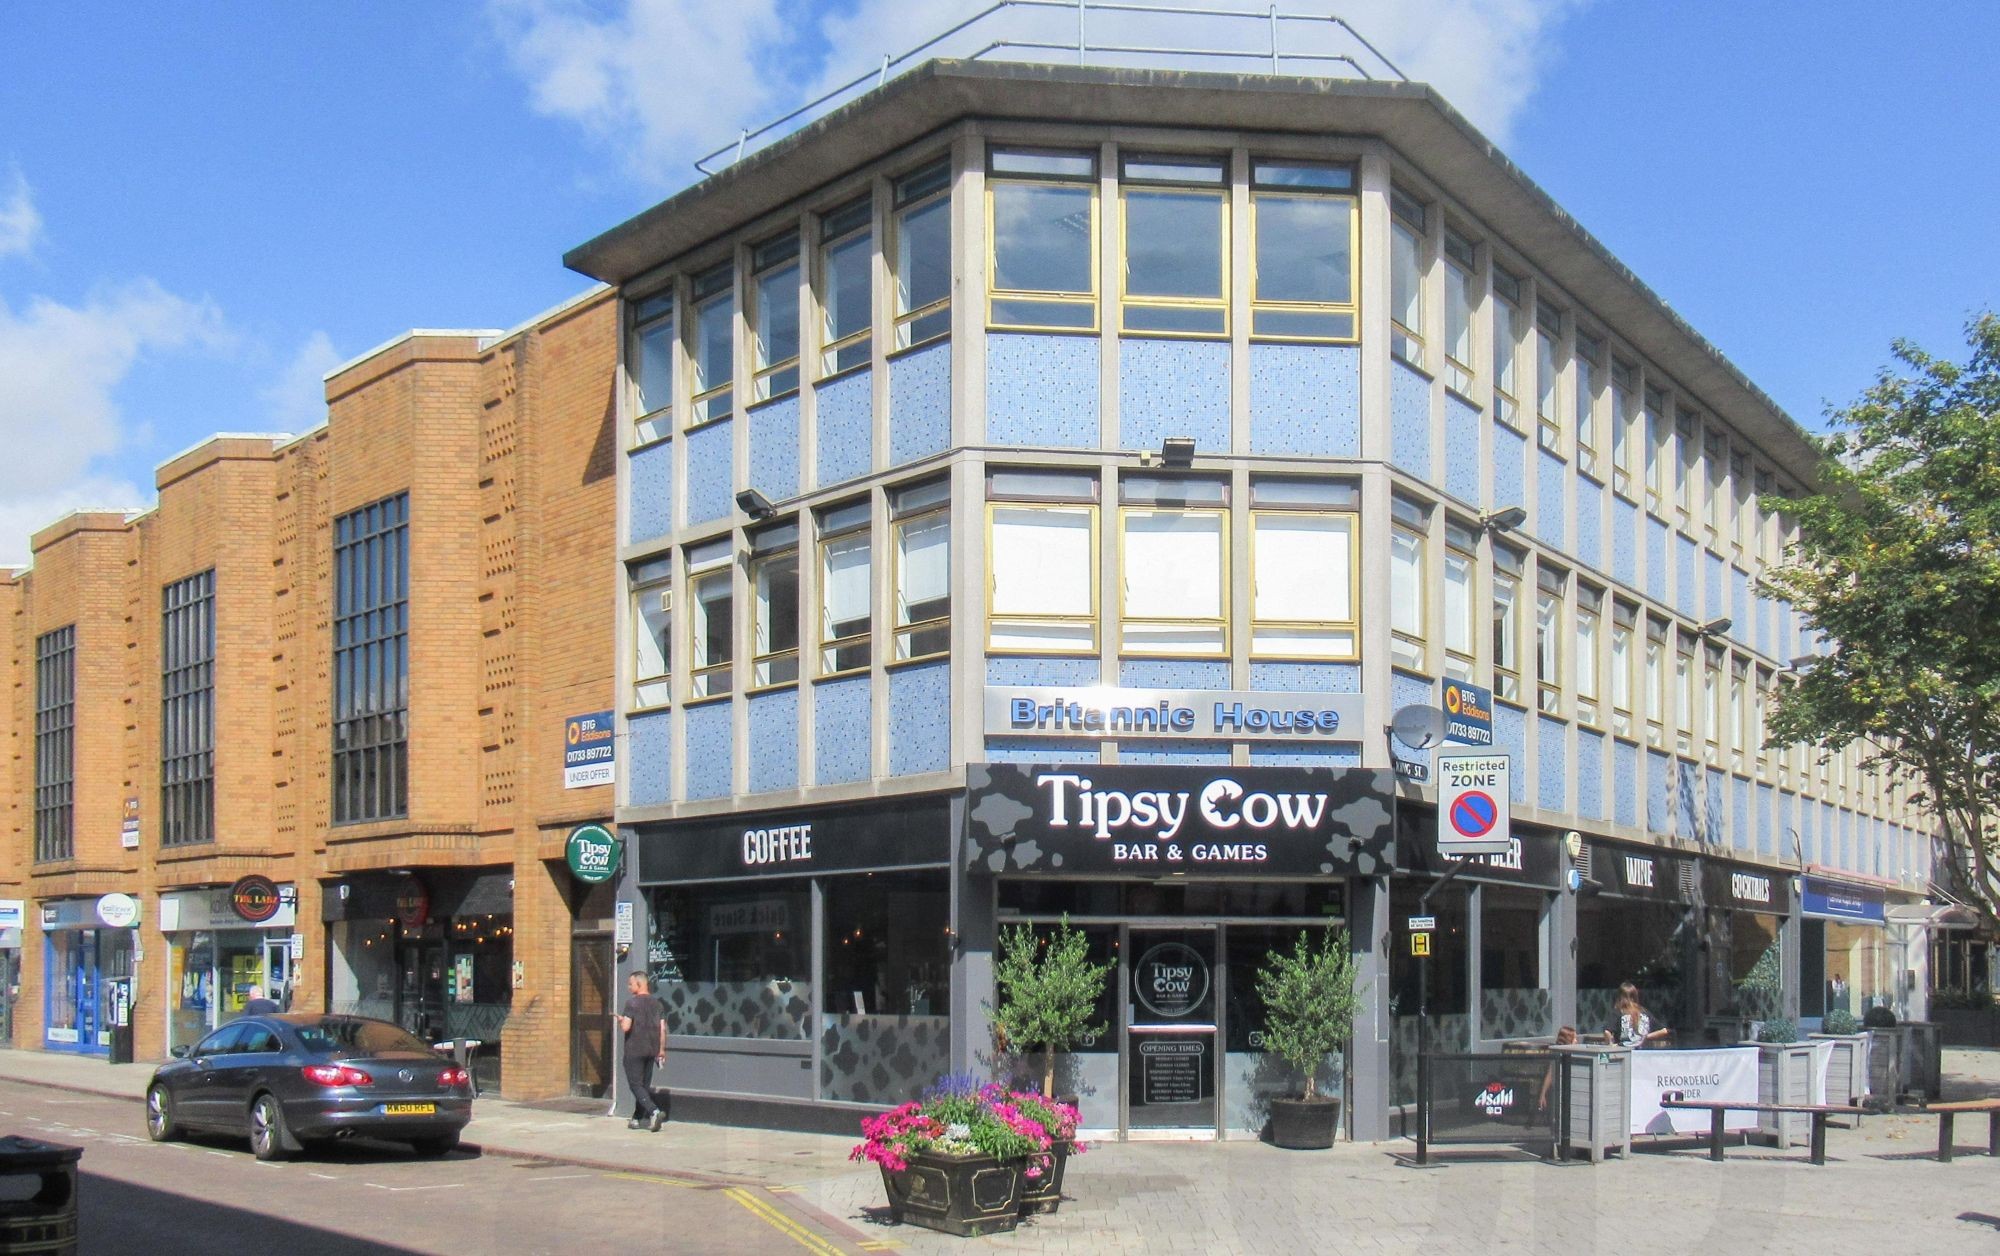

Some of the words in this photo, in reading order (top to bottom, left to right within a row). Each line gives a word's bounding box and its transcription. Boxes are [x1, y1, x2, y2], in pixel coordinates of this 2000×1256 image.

[1461, 689, 1476, 704] BTG
[1010, 697, 1195, 732] Britannic
[1213, 702, 1341, 734] House
[1462, 703, 1490, 721] Eddisons
[581, 720, 596, 731] BTG
[581, 730, 612, 742] Eddisons
[1467, 725, 1491, 744] 897722
[567, 749, 586, 762] 01733
[586, 746, 612, 760] 897722
[1443, 760, 1505, 772] Restricted
[569, 770, 589, 782] UNDER
[589, 768, 610, 780] OFFER
[1451, 774, 1496, 787] ZONE
[1037, 774, 1190, 839] Tipsy
[1200, 778, 1328, 828] Cow
[577, 839, 612, 857] Tipsy
[744, 824, 812, 865] COFFEE
[1113, 844, 1159, 861] BAR
[1166, 844, 1184, 861] &
[1192, 844, 1268, 861] GAMES
[580, 852, 609, 866] Cow
[1625, 856, 1654, 887] WINE
[1731, 873, 1770, 903] COCKTAILS
[1414, 935, 1427, 953] H
[1150, 962, 1193, 981] Tipsy
[1153, 977, 1190, 993] Cow
[1142, 1044, 1177, 1052] OPENING
[1179, 1044, 1201, 1052] TIMES
[1657, 1073, 1720, 1087] REKORDERLIG
[1474, 1088, 1513, 1106] Asahi
[1680, 1088, 1701, 1099] IDER
